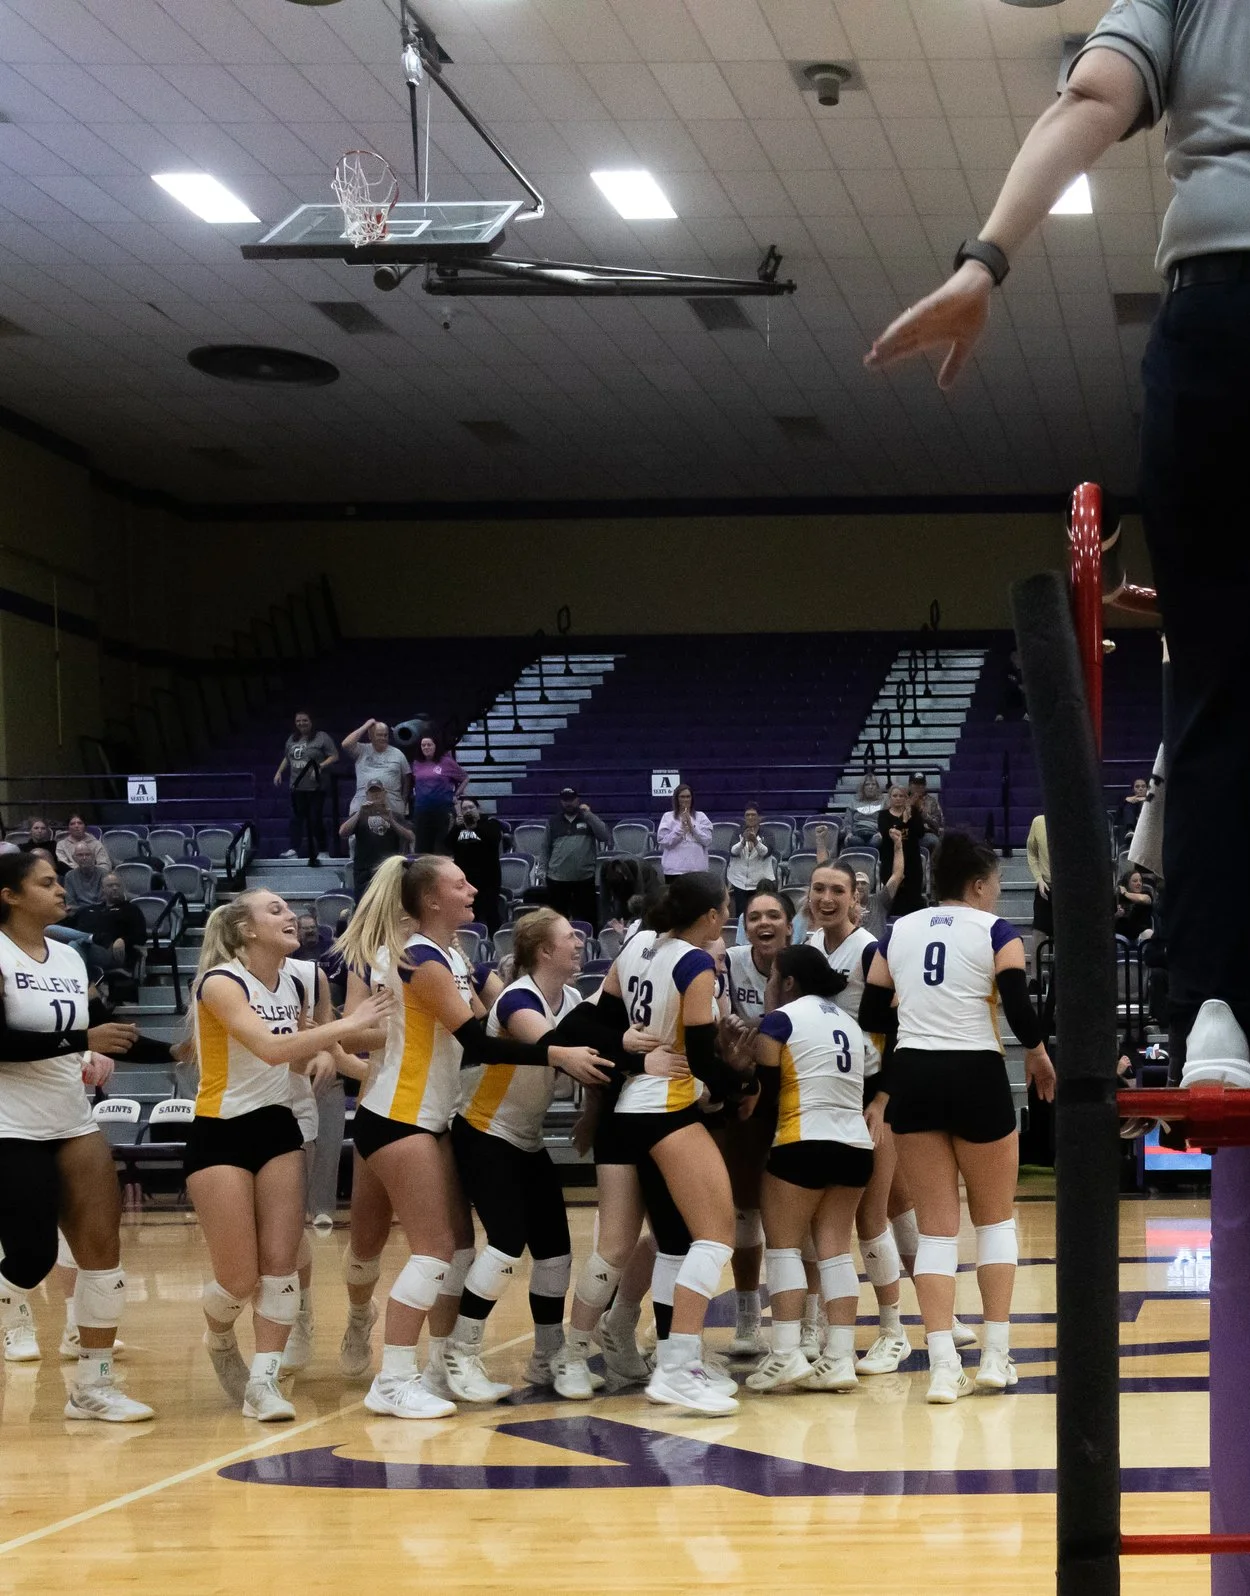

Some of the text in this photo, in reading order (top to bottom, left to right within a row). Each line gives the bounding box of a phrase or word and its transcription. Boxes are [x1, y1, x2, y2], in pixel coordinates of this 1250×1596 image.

[136, 784, 148, 795] A
[660, 776, 672, 788] A
[923, 941, 946, 987] 9
[15, 972, 85, 995] BELLEVUE
[628, 975, 654, 1028] 23
[49, 999, 76, 1032] 17
[251, 1004, 300, 1021] ELLEVUE
[832, 1029, 852, 1074] 3
[99, 1105, 133, 1114] SAINTS
[158, 1105, 192, 1114] SAINTS
